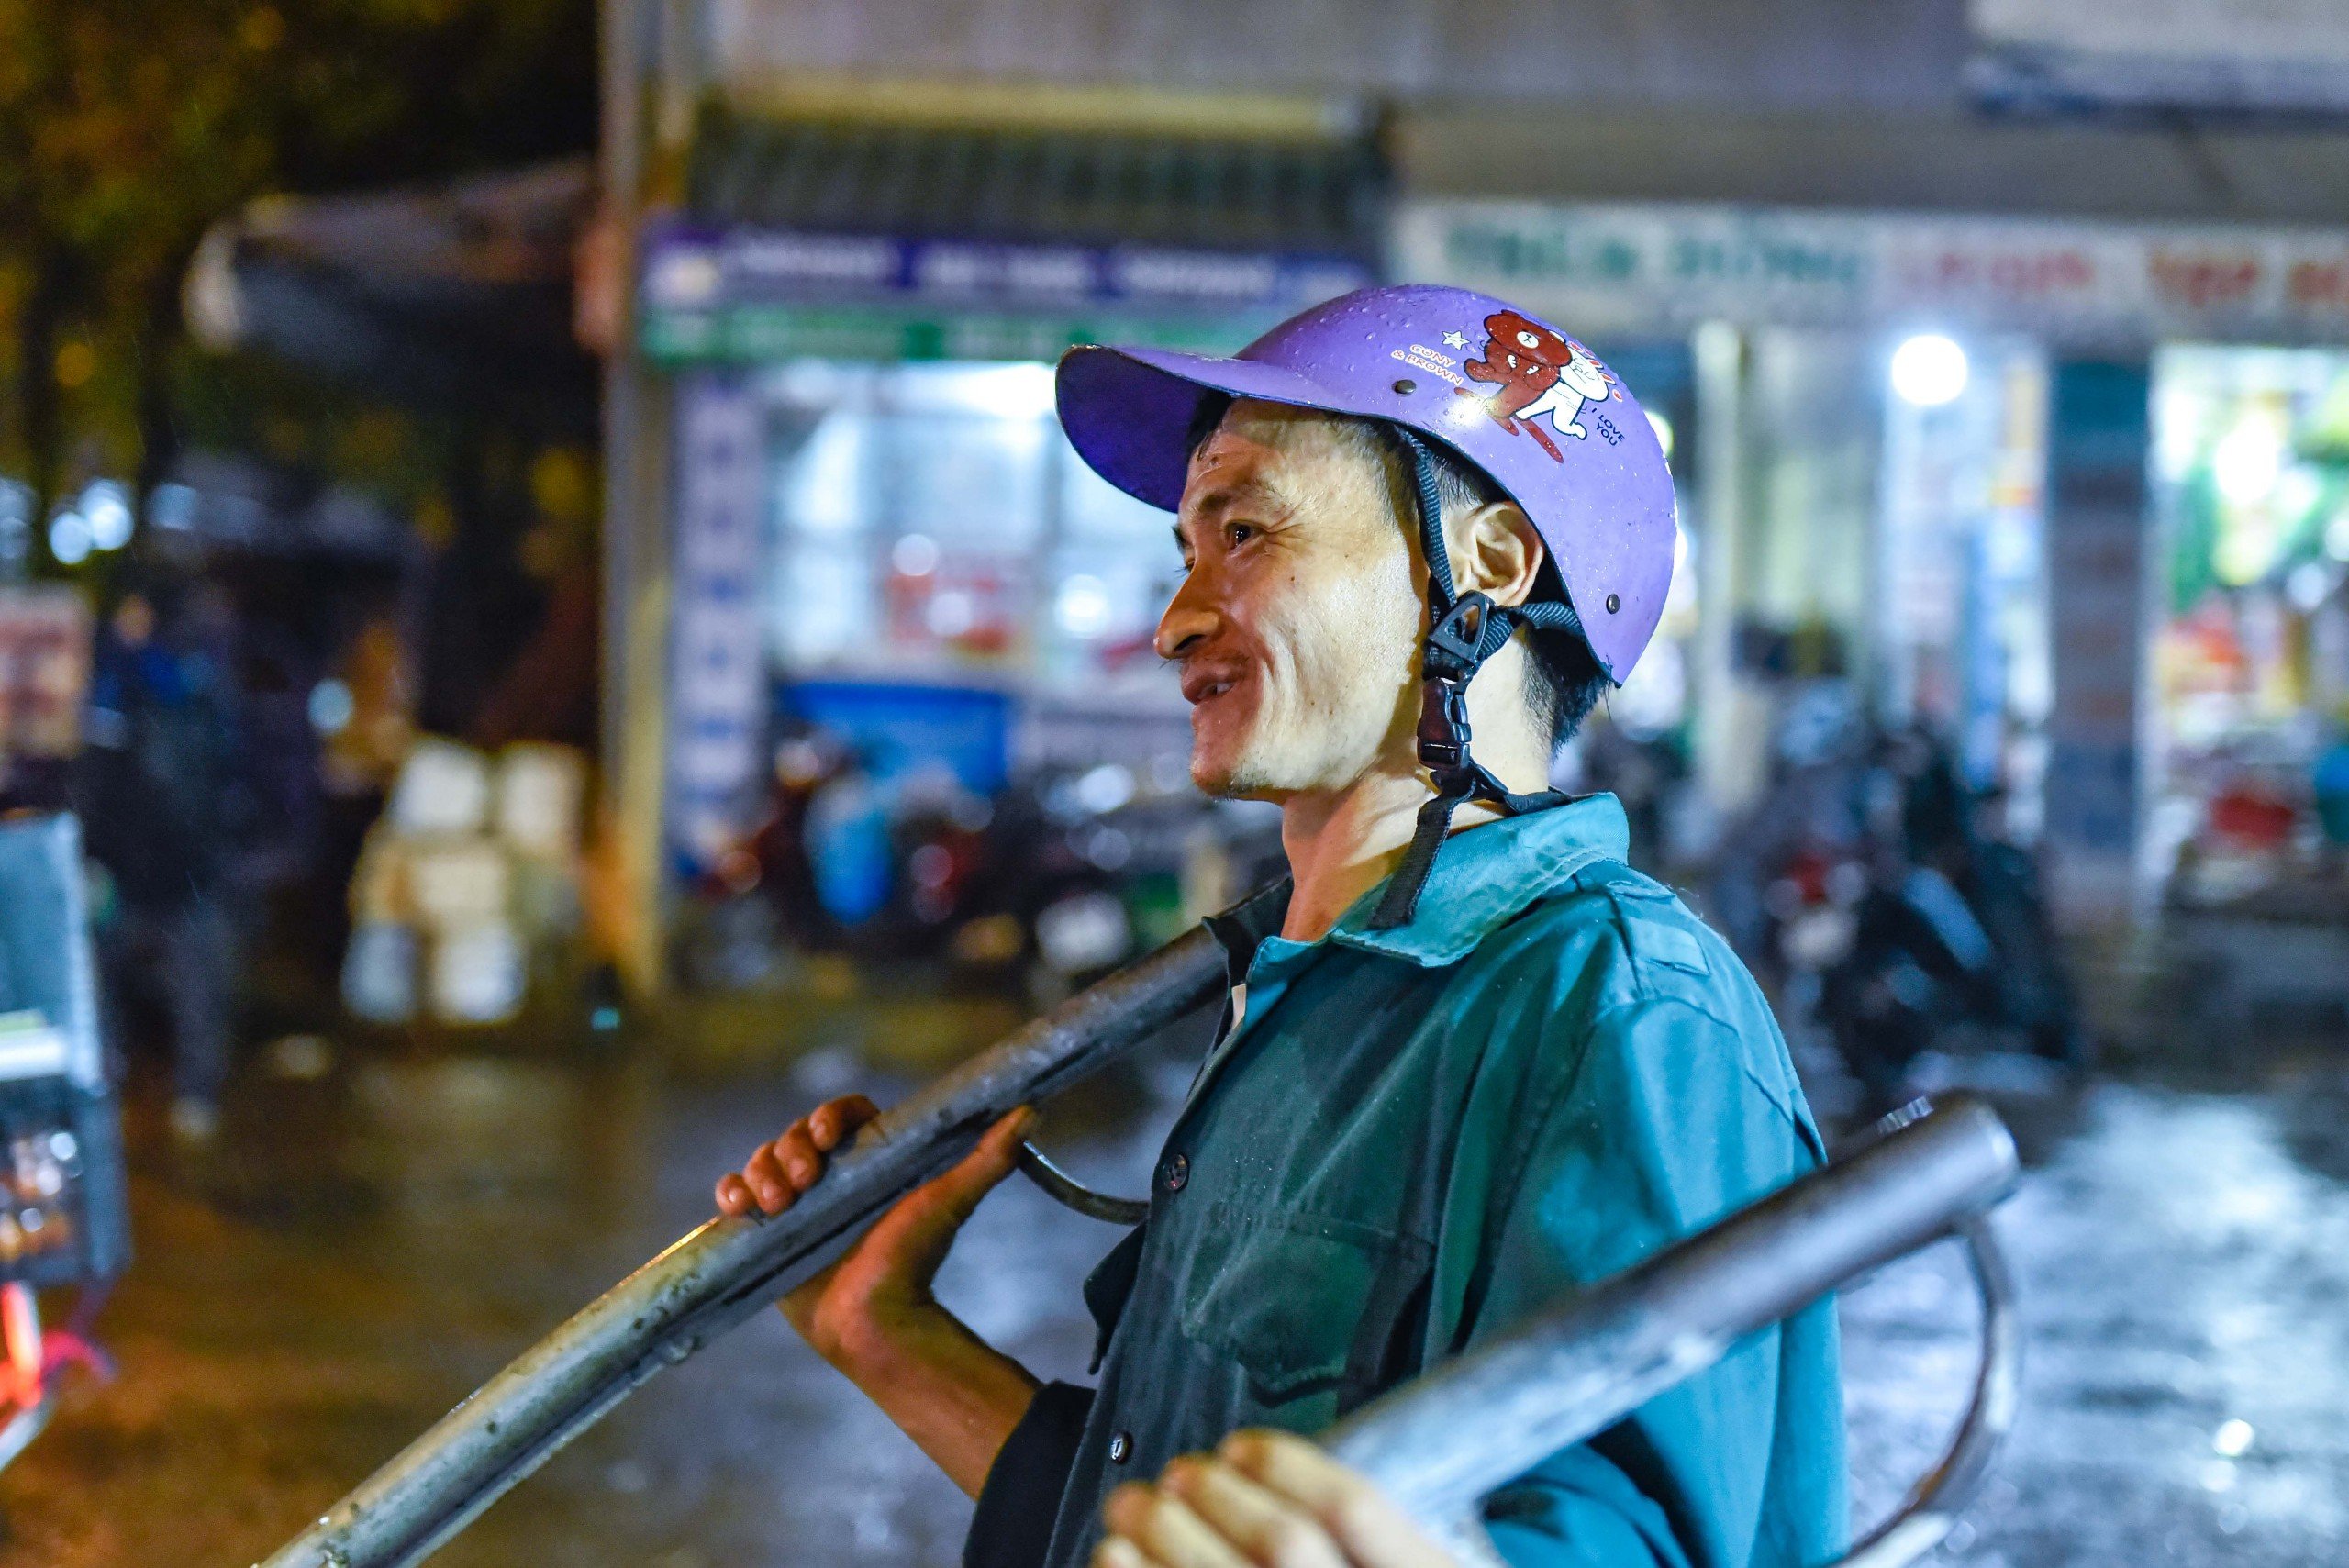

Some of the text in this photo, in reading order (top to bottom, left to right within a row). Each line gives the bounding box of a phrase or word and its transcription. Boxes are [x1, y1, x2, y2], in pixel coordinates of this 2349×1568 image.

[1391, 350, 1464, 385] & BROWN
[1410, 344, 1456, 367] CONY
[1596, 422, 1618, 447] YOU
[1598, 414, 1625, 442] LOVE
